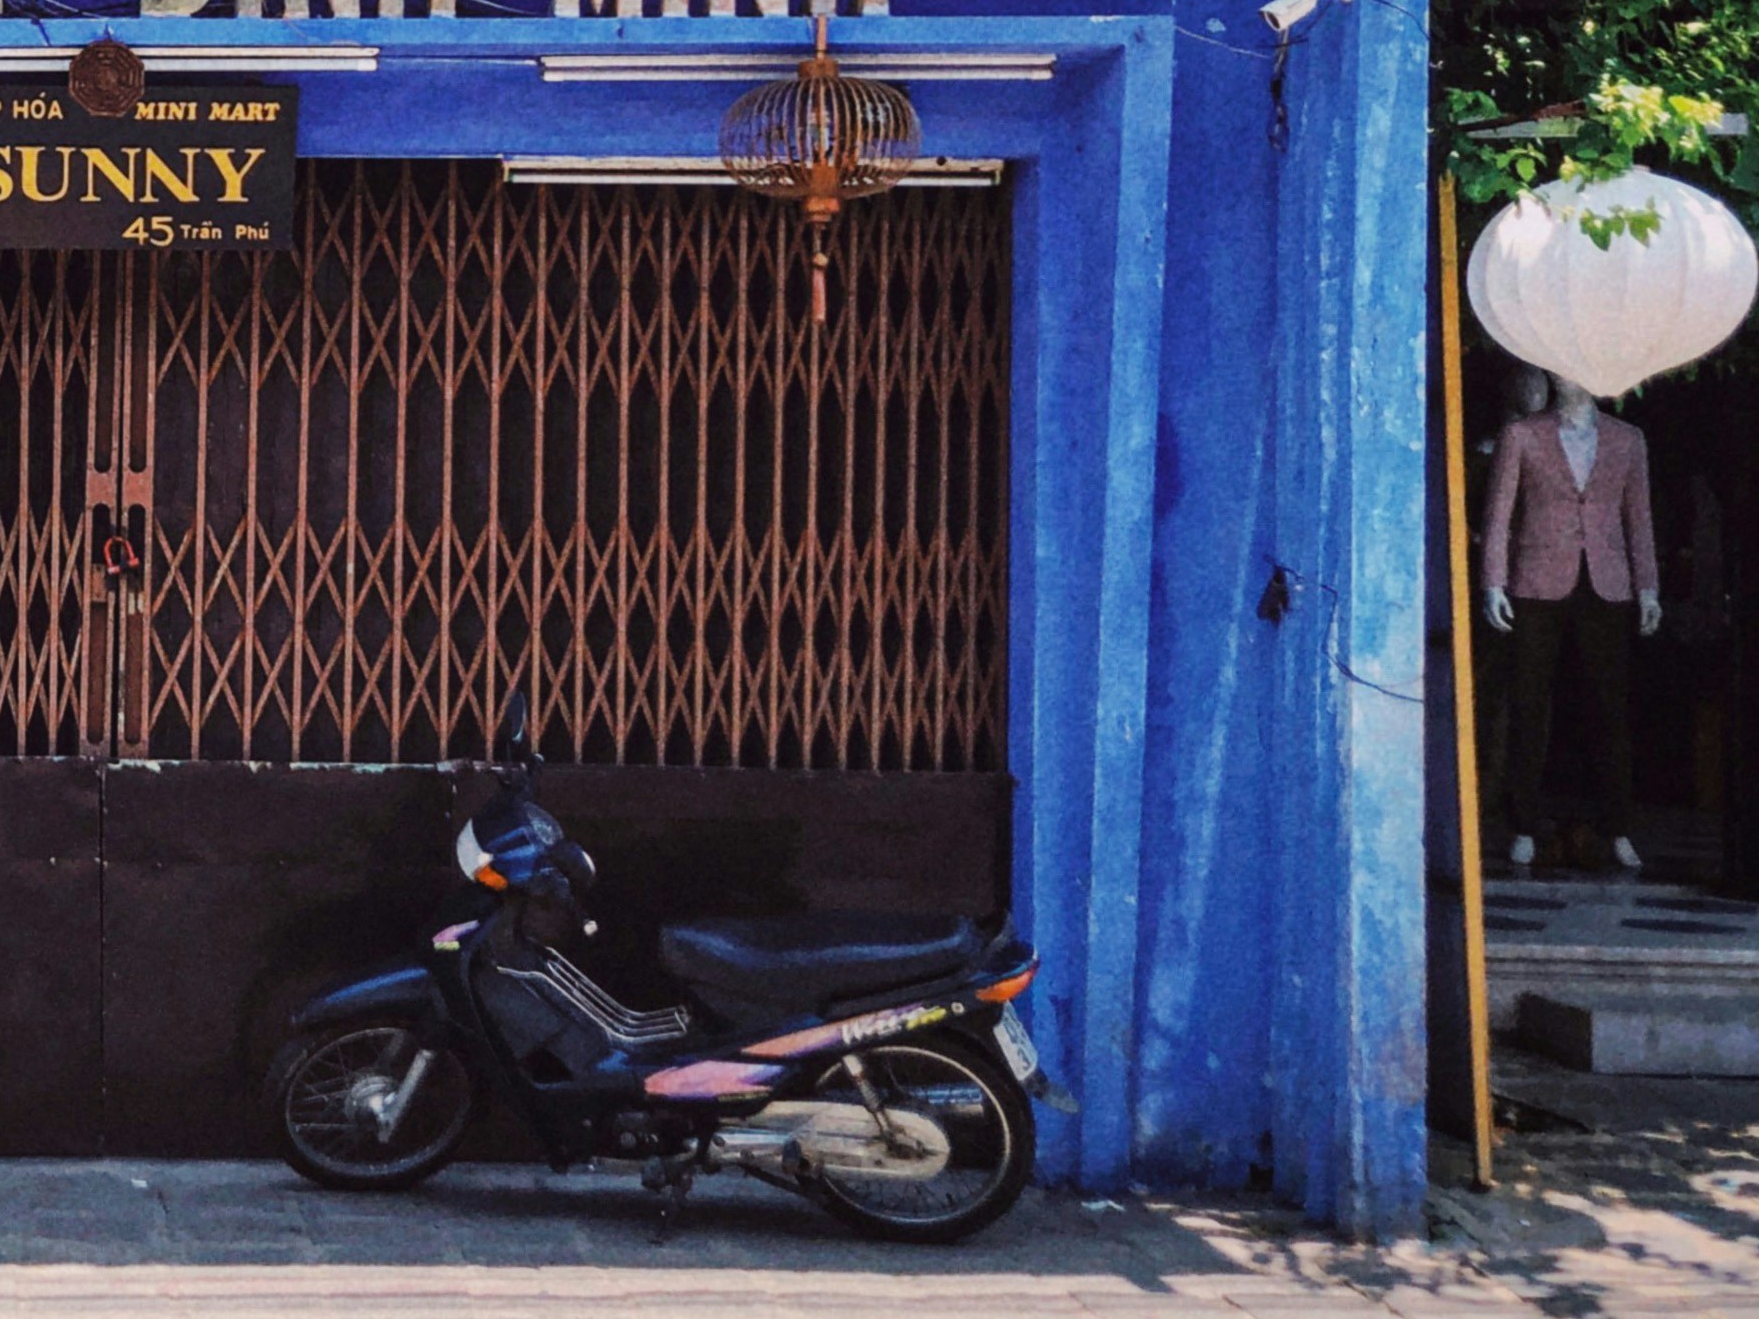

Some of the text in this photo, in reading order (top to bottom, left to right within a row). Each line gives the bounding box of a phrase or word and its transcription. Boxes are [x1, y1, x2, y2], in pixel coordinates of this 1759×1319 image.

[12, 92, 64, 120] HÓA
[134, 101, 281, 121] MINI MART
[121, 216, 175, 247] 45
[235, 221, 270, 240] Phú
